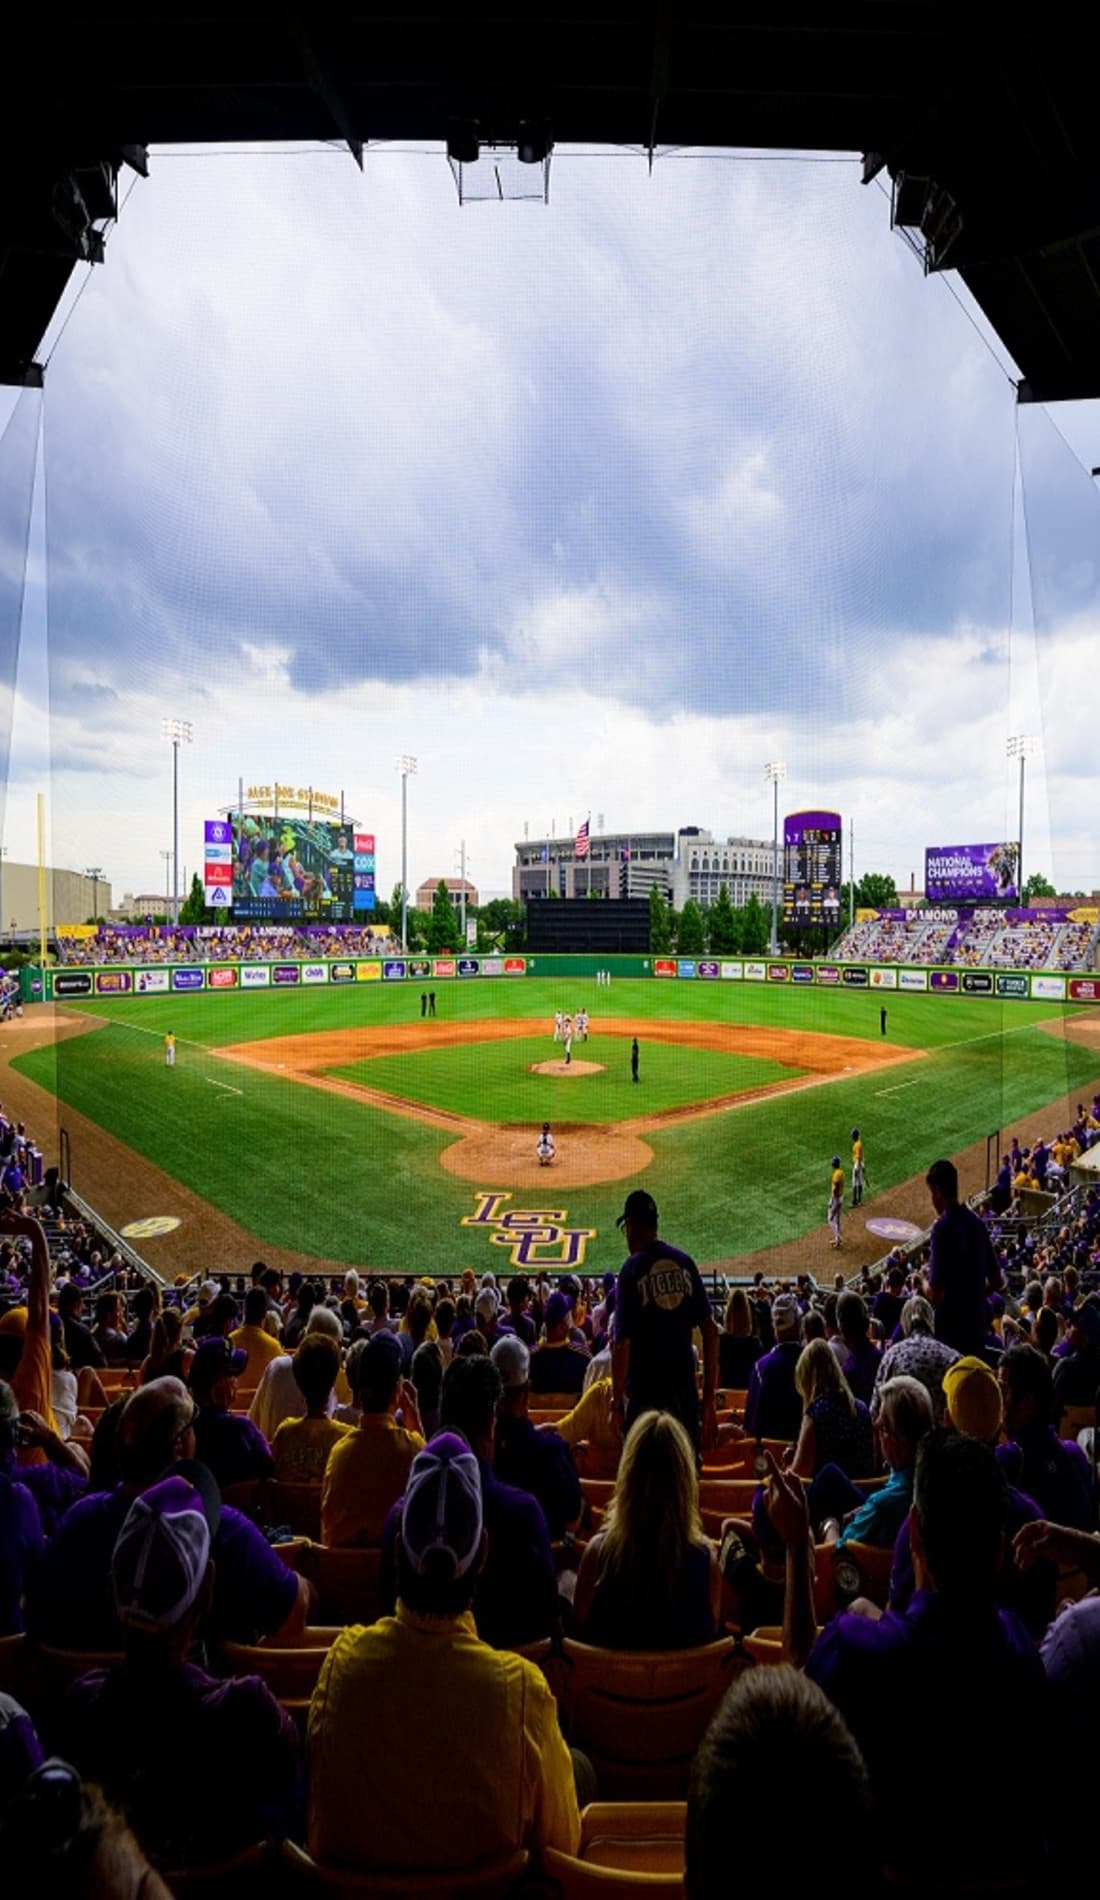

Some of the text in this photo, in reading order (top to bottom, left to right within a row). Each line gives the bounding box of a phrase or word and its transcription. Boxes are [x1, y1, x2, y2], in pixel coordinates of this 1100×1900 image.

[928, 856, 972, 868] NATIONAL
[928, 866, 982, 878] CHAMPIONS
[906, 909, 1007, 920] DIAMOND DECK
[197, 927, 221, 937] LEFT
[252, 927, 293, 937] LANDING
[460, 1192, 597, 1269] LSU
[636, 1268, 693, 1306] TIGERS
